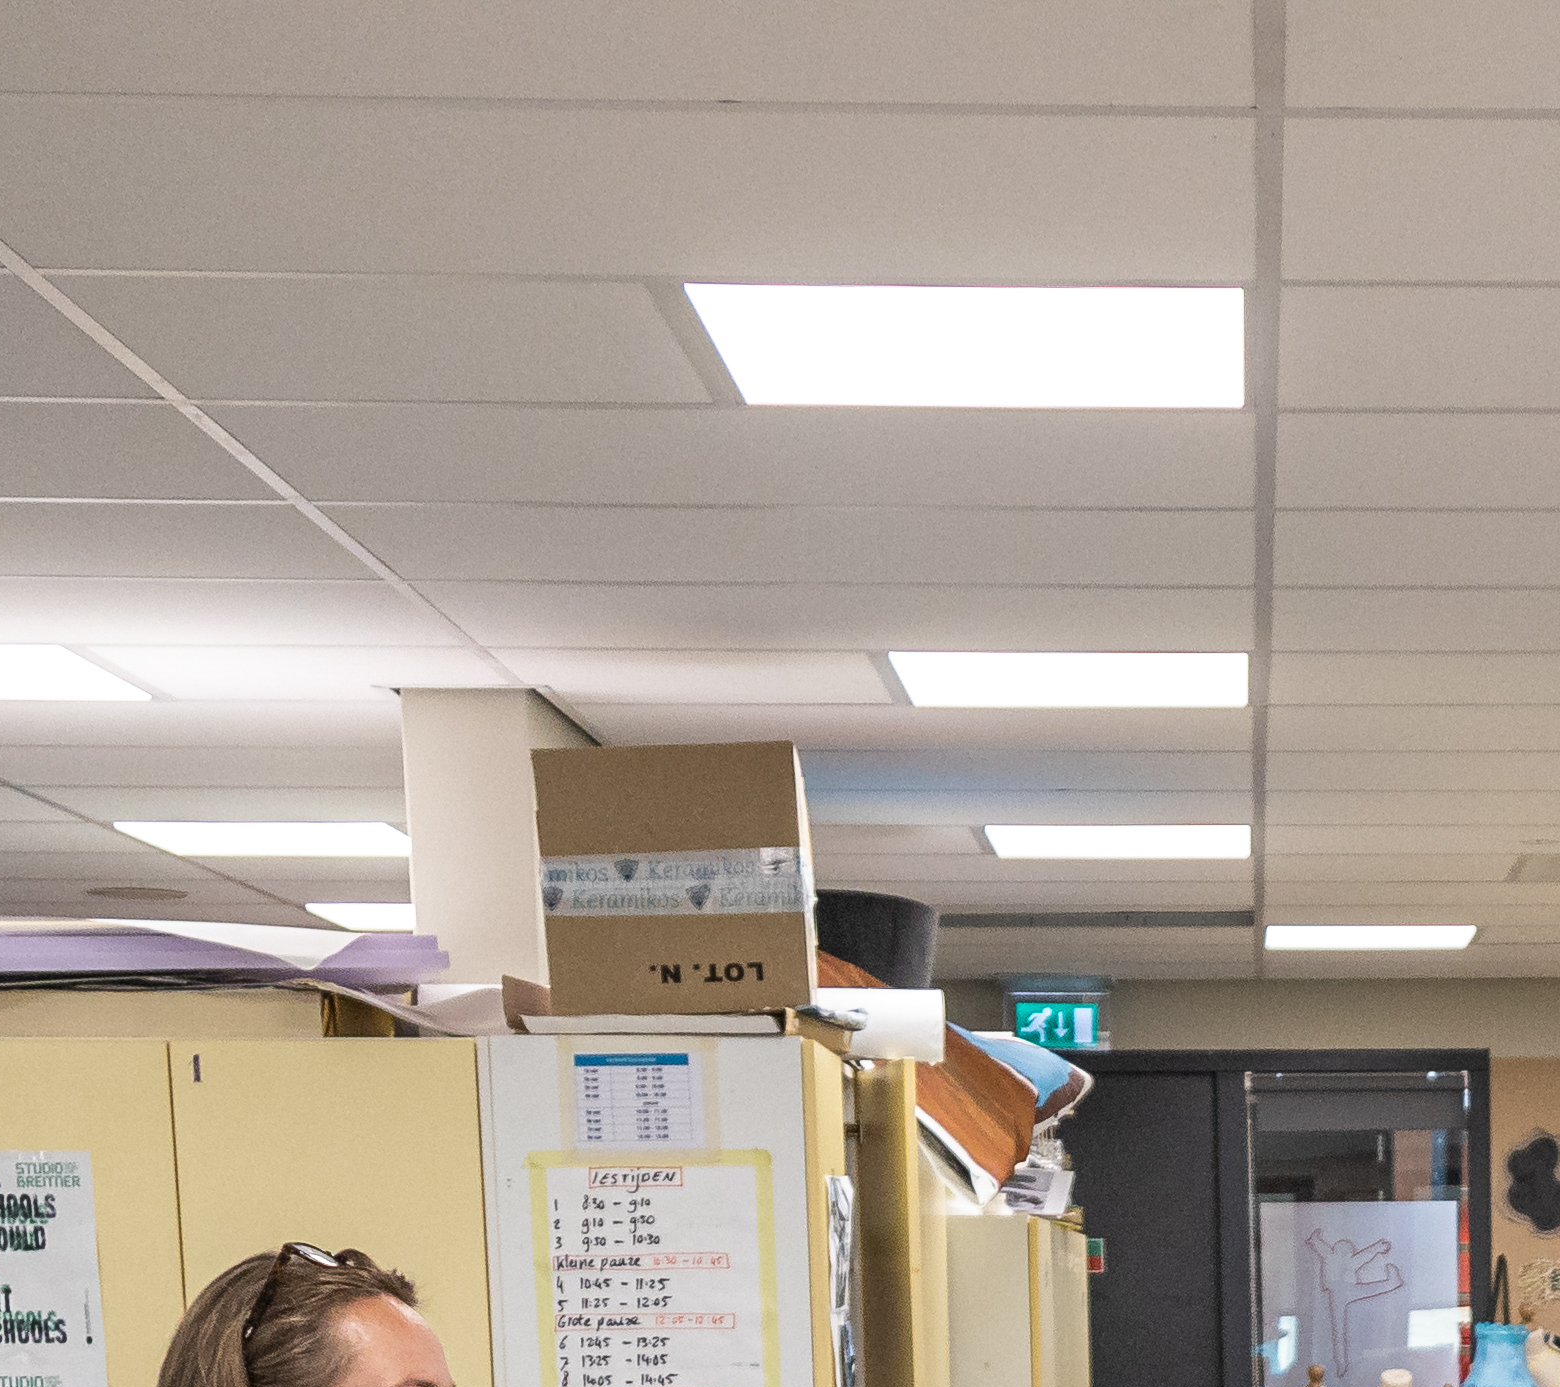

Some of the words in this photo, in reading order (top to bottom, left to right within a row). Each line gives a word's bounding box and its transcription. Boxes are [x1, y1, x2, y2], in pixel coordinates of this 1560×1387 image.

[693, 961, 765, 983] LOT.
[15, 1162, 63, 1174] STUDIO
[17, 1175, 81, 1188] BREITNER
[599, 1257, 641, 1271] pauze
[558, 1314, 592, 1328] Grote
